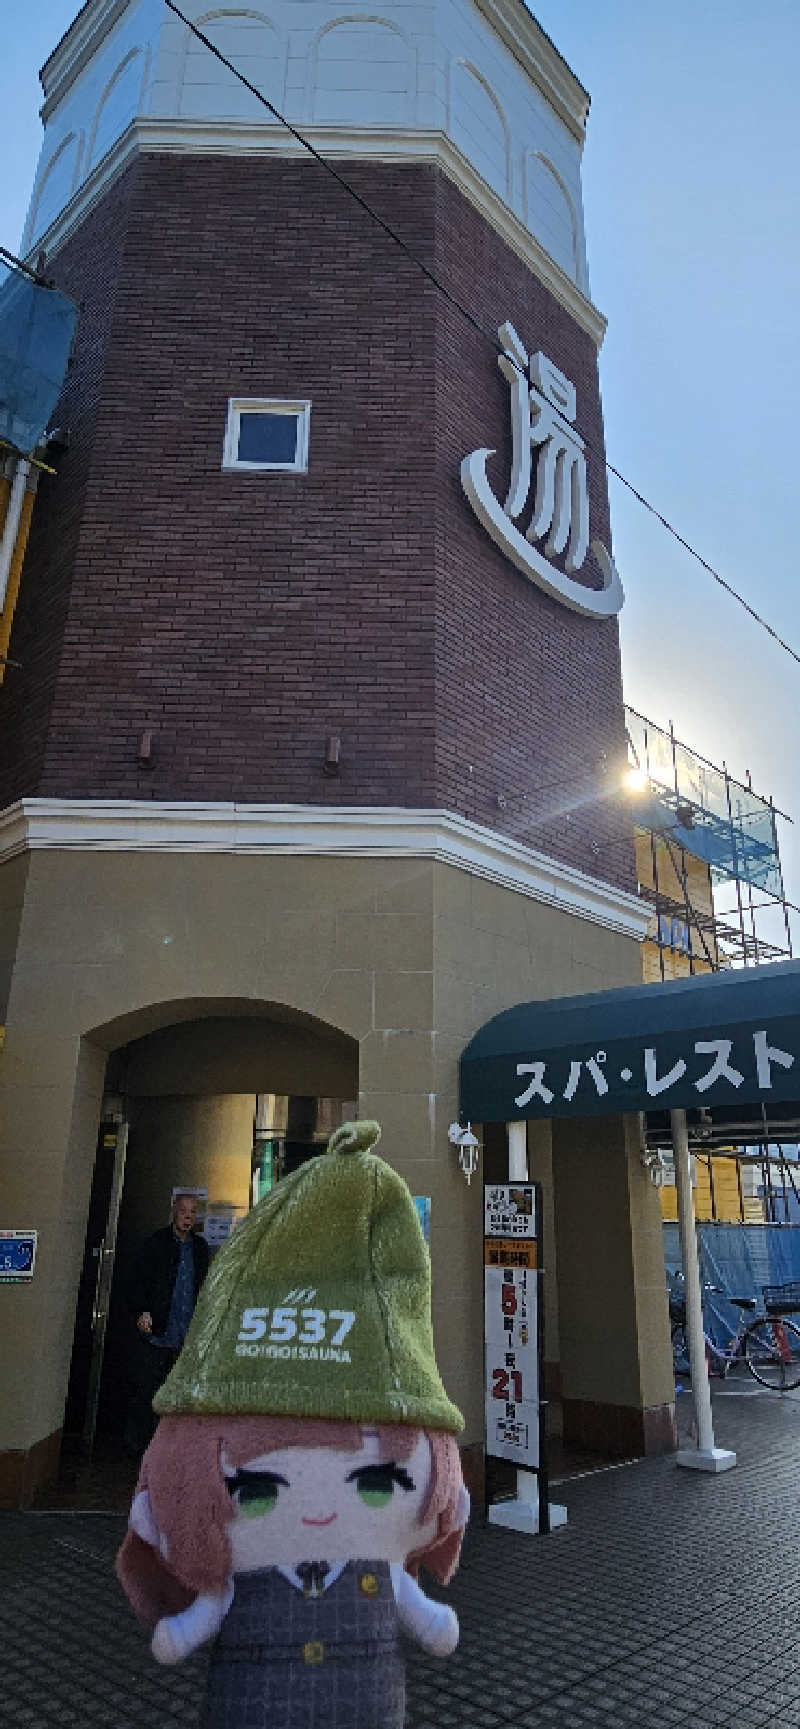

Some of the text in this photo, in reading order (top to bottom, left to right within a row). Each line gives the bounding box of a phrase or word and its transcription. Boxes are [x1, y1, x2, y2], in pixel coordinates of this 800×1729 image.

[514, 1030, 795, 1107] スパ・レスト
[237, 1307, 356, 1345] 5537
